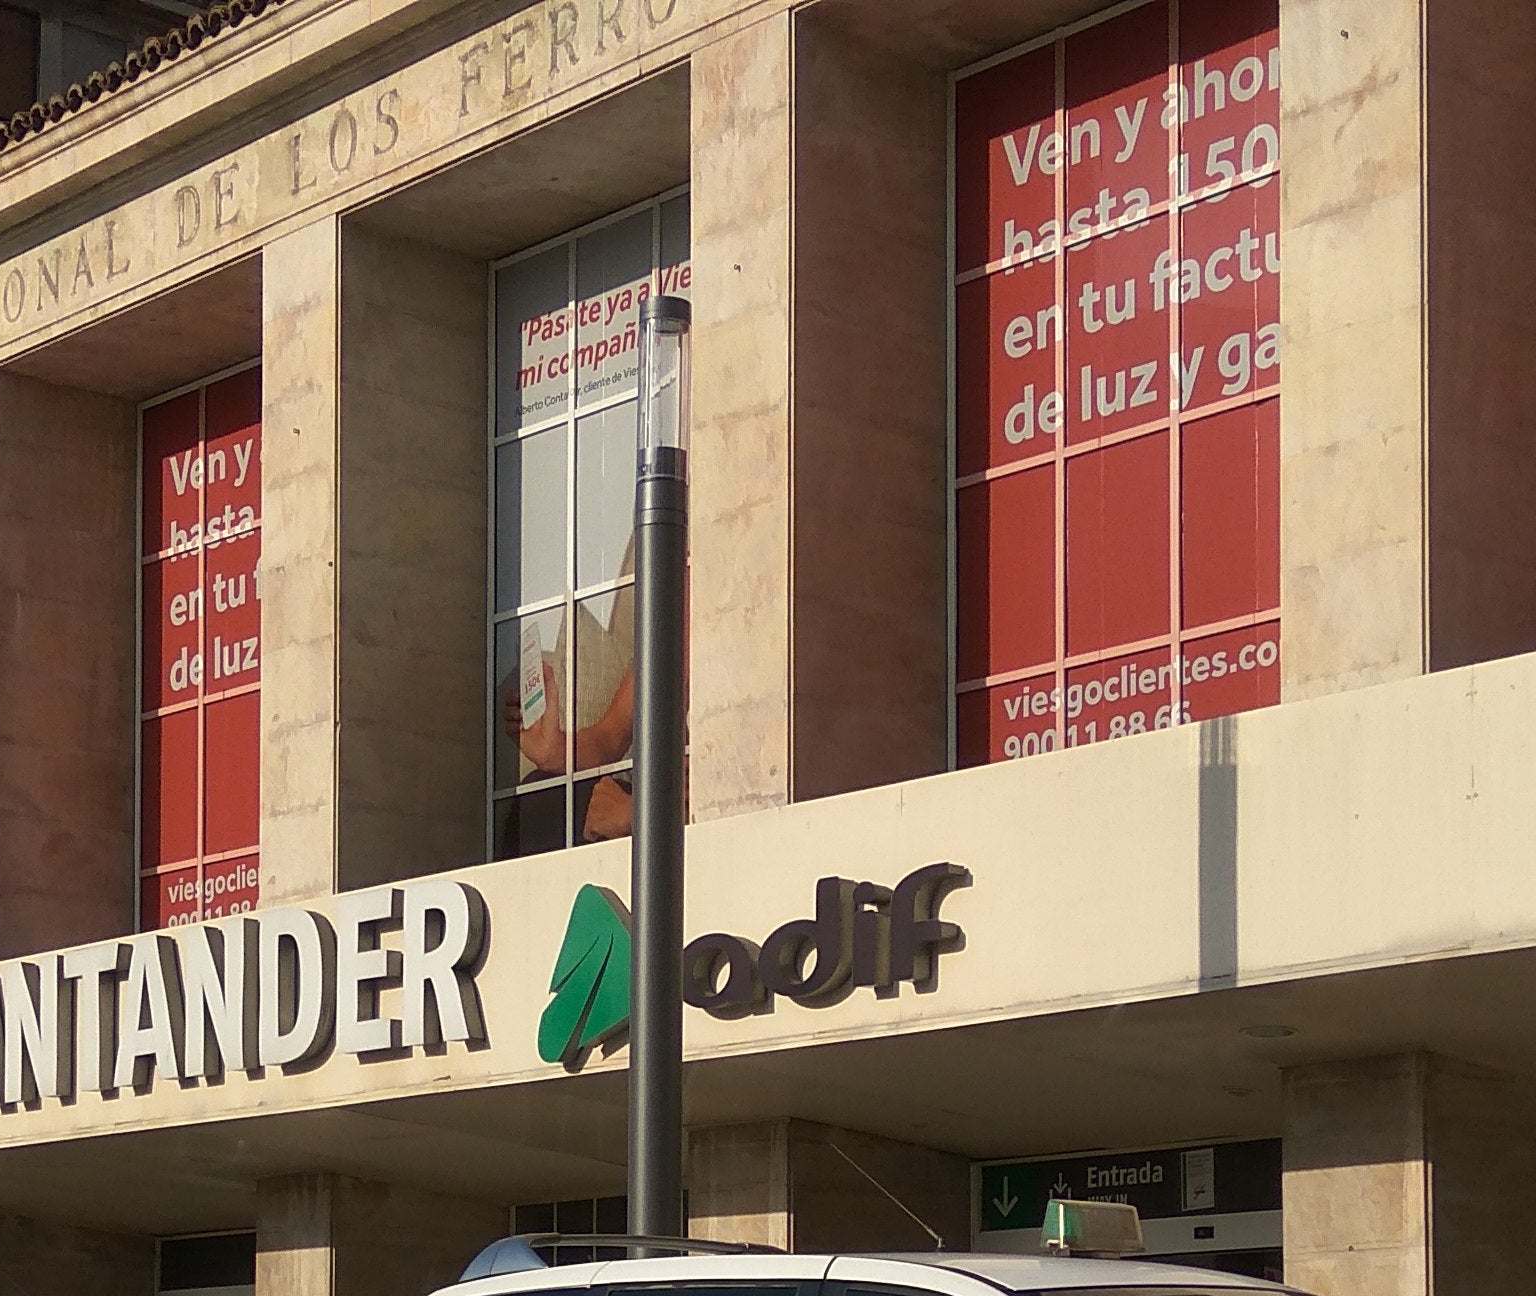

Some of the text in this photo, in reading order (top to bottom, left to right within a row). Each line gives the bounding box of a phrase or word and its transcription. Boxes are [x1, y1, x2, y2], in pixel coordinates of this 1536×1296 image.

[174, 161, 240, 249] DE
[289, 87, 401, 196] LOS
[1002, 116, 1100, 187] Ven
[1115, 97, 1148, 163] y
[1003, 186, 1151, 275] hasta
[604, 288, 633, 326] ya
[636, 282, 650, 306] a
[1003, 301, 1063, 359] en
[1078, 278, 1136, 333] tu
[516, 321, 641, 391] mi compañ
[611, 370, 623, 384] de
[1004, 322, 1281, 445] de luz y ga
[170, 438, 254, 496] Ven y
[170, 504, 255, 563] hasta
[170, 589, 204, 626] en
[213, 573, 247, 613] tu
[170, 635, 259, 693] de luz
[1003, 640, 1279, 721] viesgoclientes.co
[1004, 700, 1192, 760] 900 11 88 66
[680, 860, 974, 1018] adif
[1087, 1161, 1164, 1189] Entrada
